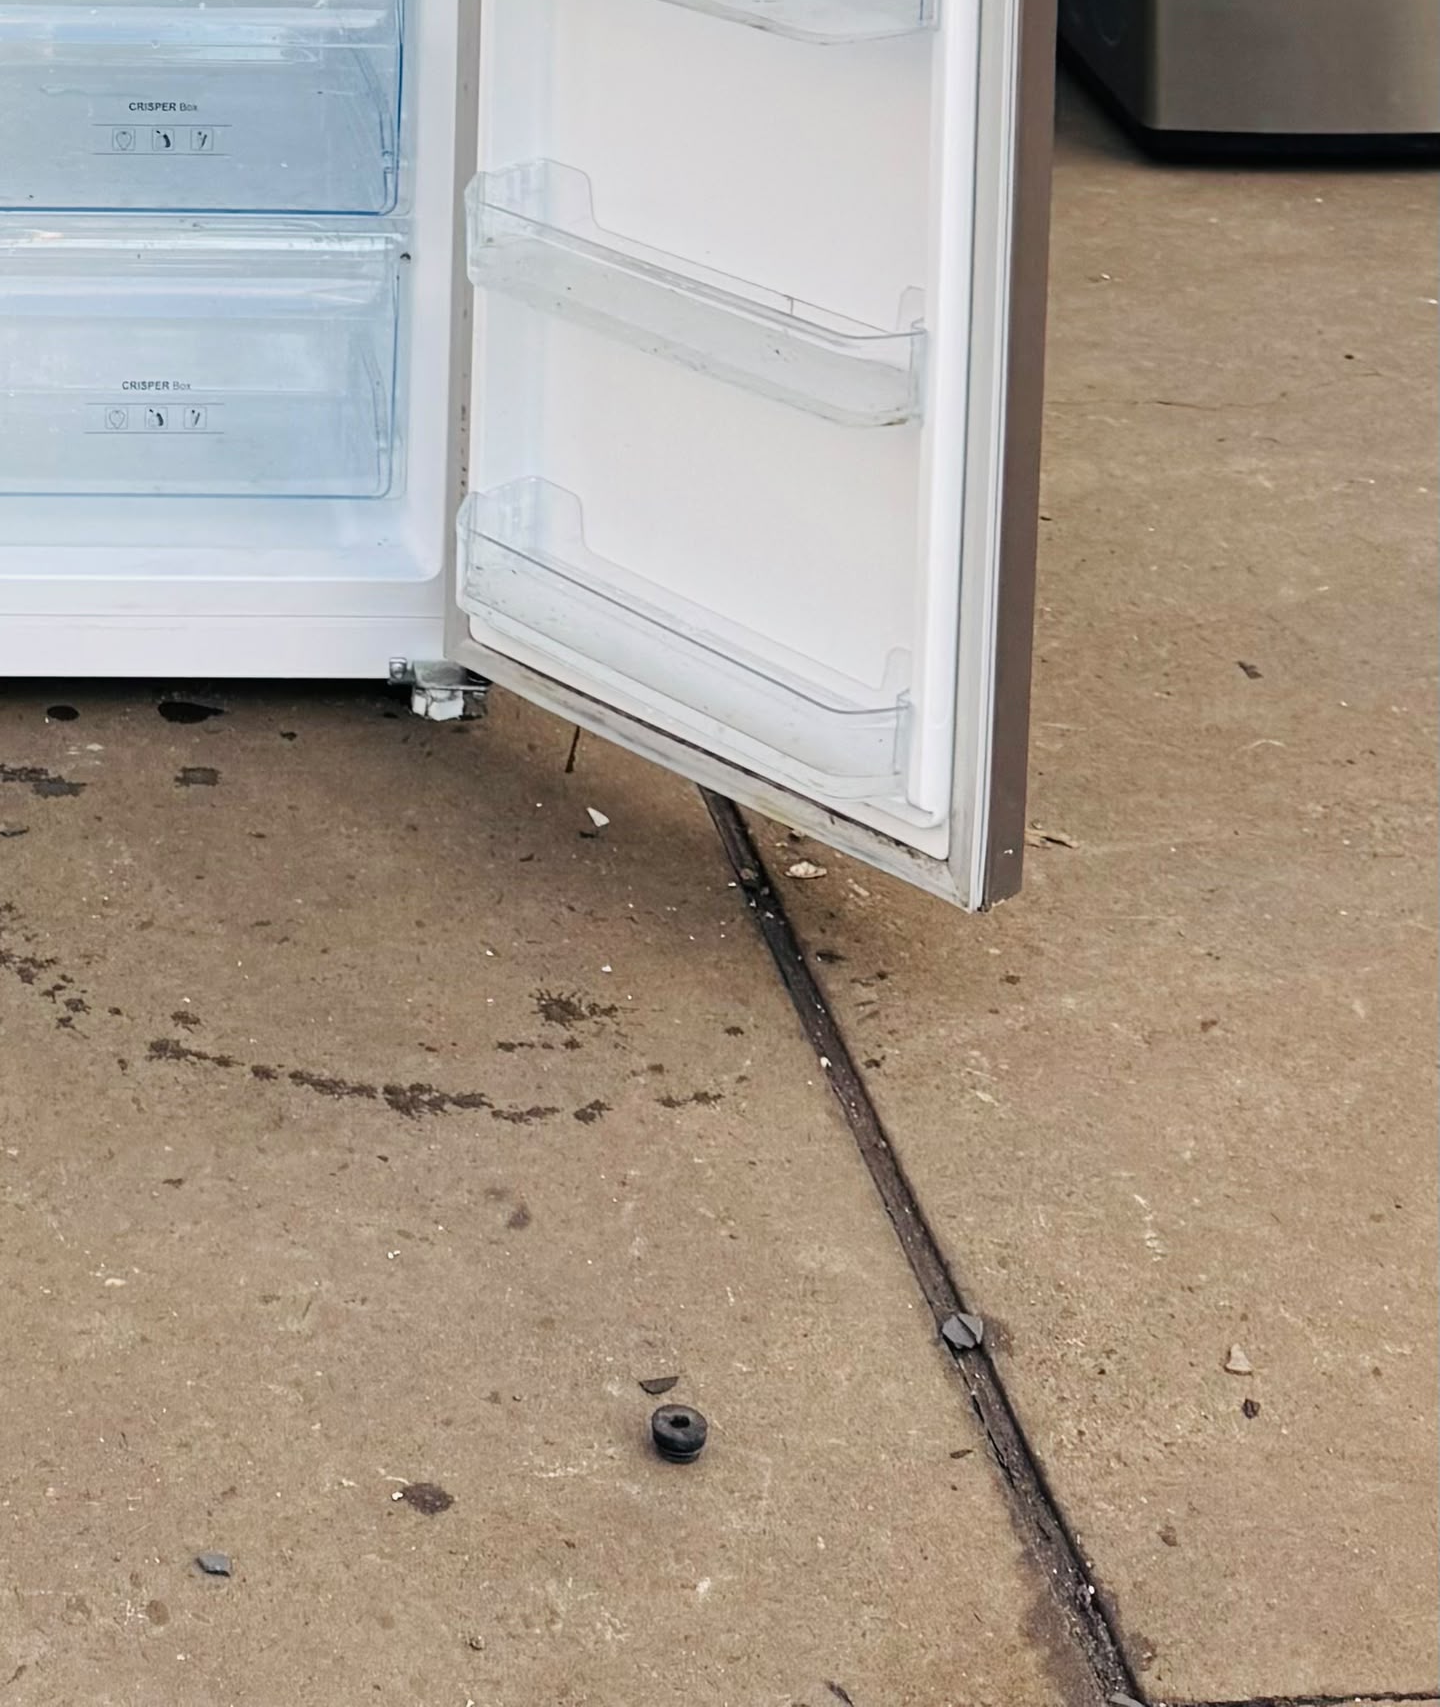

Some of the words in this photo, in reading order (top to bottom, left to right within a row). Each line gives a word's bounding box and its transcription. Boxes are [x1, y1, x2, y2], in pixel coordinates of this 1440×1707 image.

[128, 101, 177, 112] CRISPER
[179, 102, 198, 112] Box
[121, 380, 170, 391] CRISPER
[172, 381, 192, 391] Box
